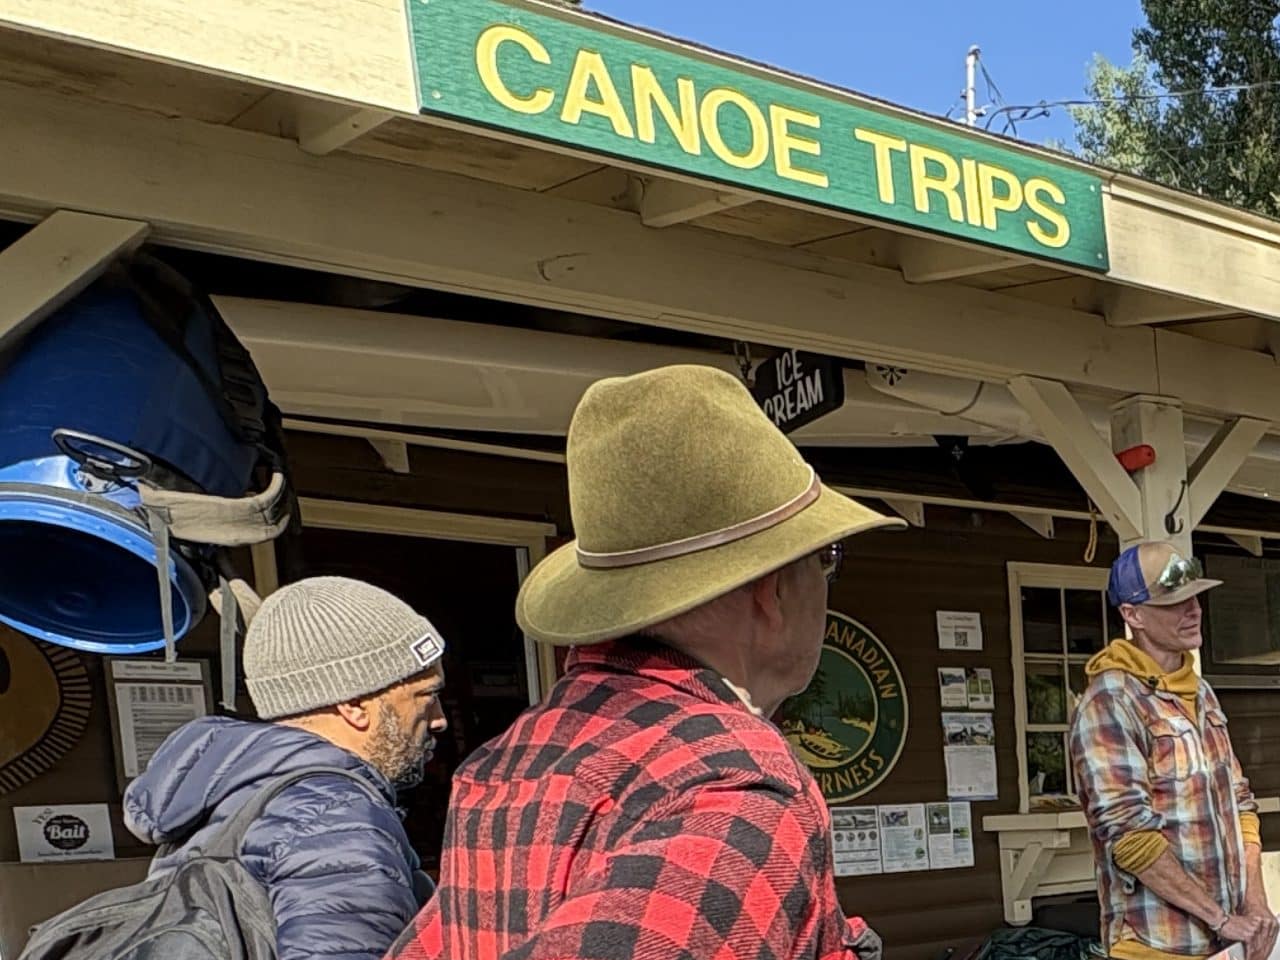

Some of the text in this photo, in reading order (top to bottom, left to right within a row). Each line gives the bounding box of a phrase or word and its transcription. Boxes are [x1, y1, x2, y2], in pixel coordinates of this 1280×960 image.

[475, 24, 1071, 249] CANOE TRIPS
[775, 348, 804, 391] ICE
[763, 368, 824, 426] CREAM
[825, 620, 898, 700] ANADIAN
[820, 749, 885, 794] RNESS
[46, 824, 86, 840] Bait
